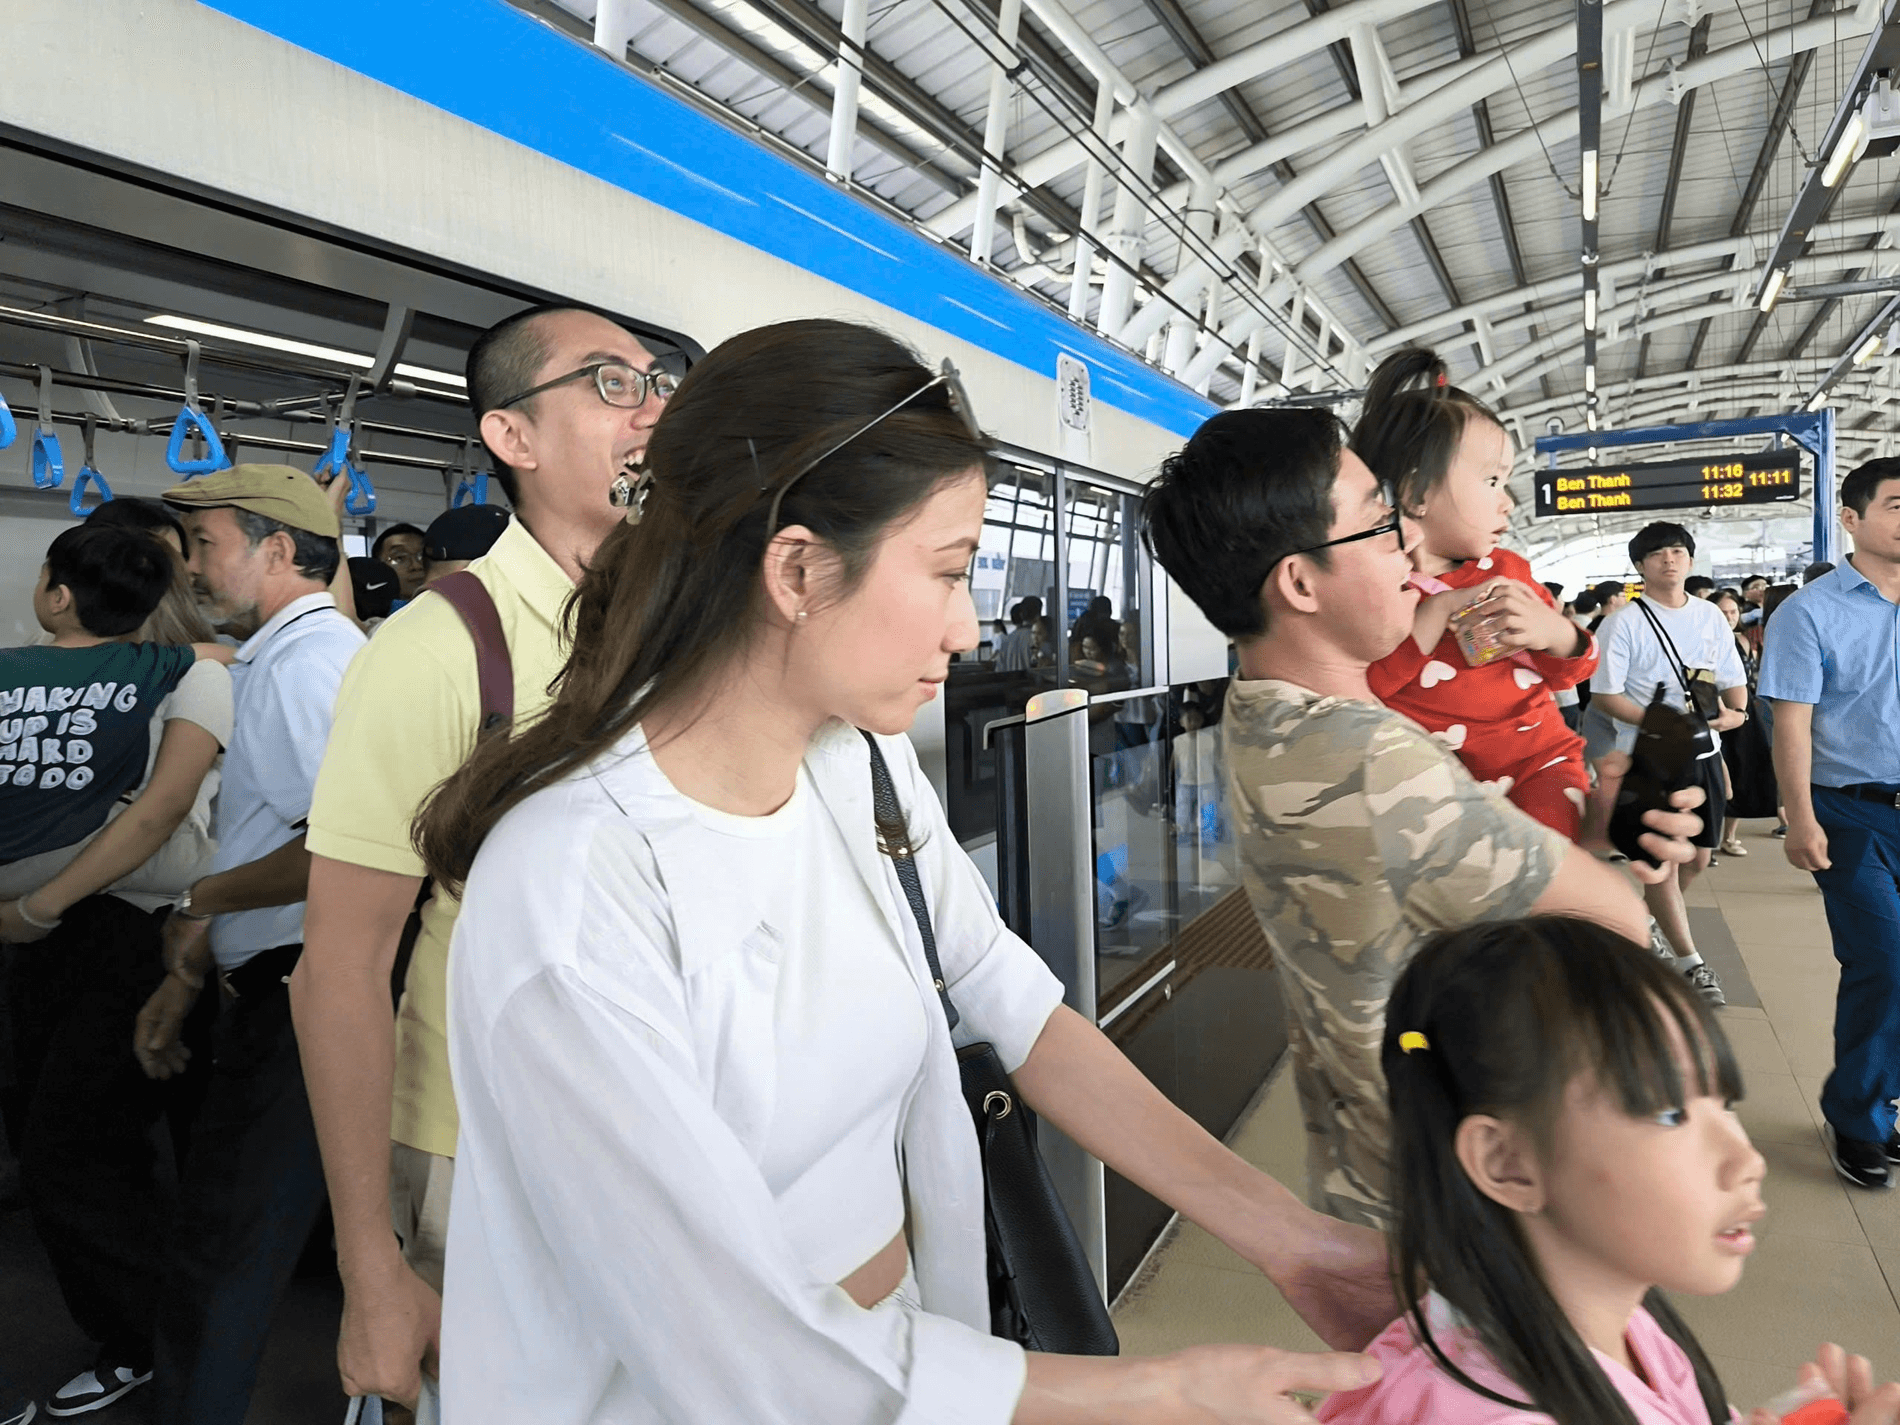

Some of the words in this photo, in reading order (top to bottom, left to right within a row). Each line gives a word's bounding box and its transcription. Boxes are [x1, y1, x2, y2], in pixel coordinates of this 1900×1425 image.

[1556, 478, 1585, 492] Ben
[1588, 473, 1631, 489] Thanh
[1701, 463, 1743, 480] 11:16
[1749, 470, 1791, 486] 11:11
[1541, 483, 1551, 504] 1
[1556, 496, 1585, 510] Ben
[1588, 492, 1631, 507] Thanh
[1701, 483, 1743, 499] 11:32
[0, 715, 49, 744] UP
[56, 708, 98, 736] IS
[0, 763, 36, 786] TO
[39, 765, 95, 791] DO
